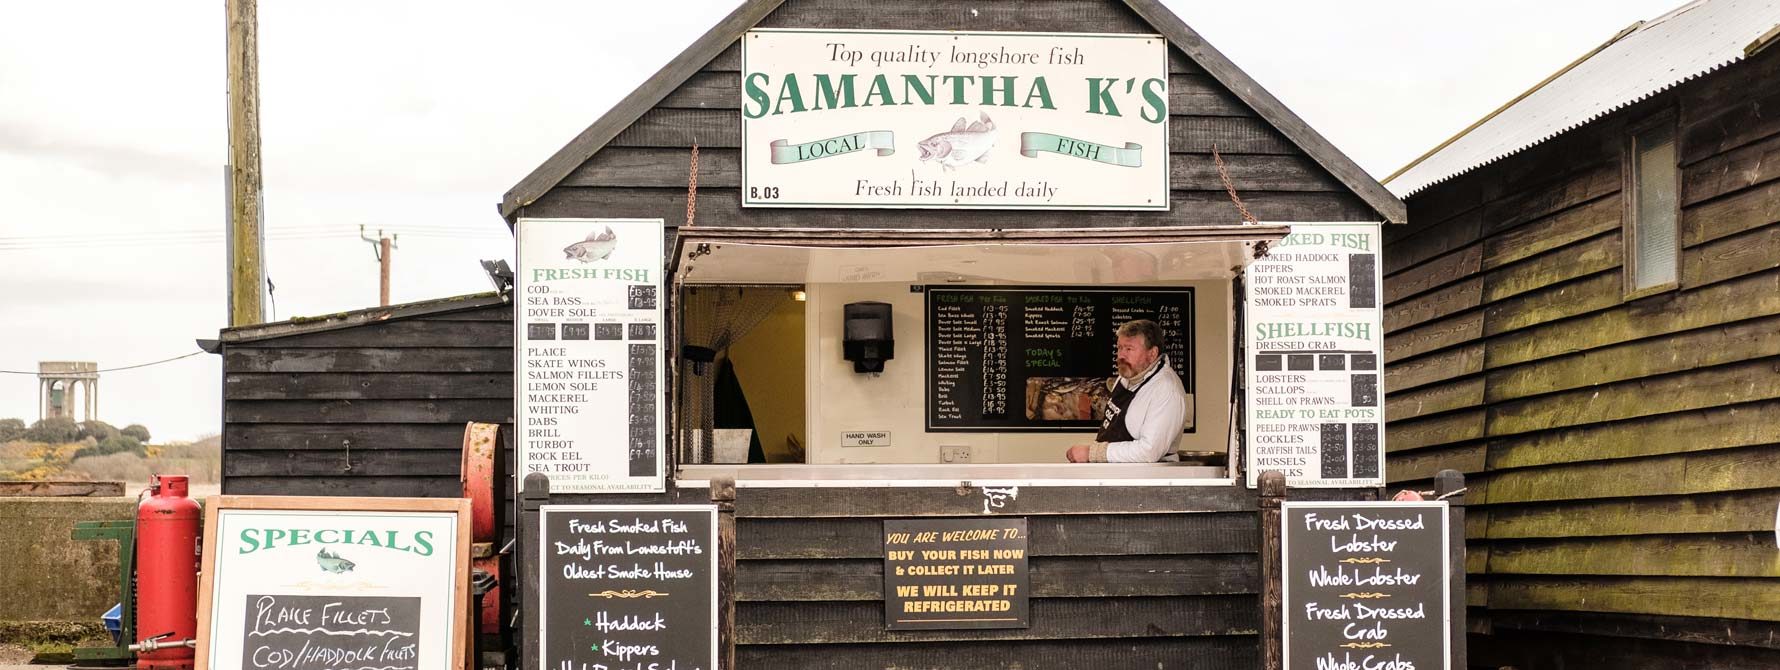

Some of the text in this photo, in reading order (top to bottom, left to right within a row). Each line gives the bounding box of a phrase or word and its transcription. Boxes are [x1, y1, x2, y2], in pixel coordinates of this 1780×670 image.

[826, 43, 1085, 69] Top quality longshore fish
[744, 72, 1167, 124] SAMANTHA K'S
[798, 135, 866, 160] LOCAL
[1057, 138, 1101, 160] FISH
[855, 173, 1058, 202] Fresh fish landed daily
[1331, 233, 1370, 251] FISH
[1295, 254, 1339, 262] HADDOCK
[533, 268, 649, 282] FRESH FISH
[1255, 276, 1346, 284] HOT ROAST SALMON
[527, 286, 549, 294] COD
[1255, 287, 1345, 295] SMOKED MACKEREL
[527, 297, 548, 305] SEA
[553, 297, 581, 305] BASS
[1255, 298, 1337, 306] SMOKED SPRATS
[528, 309, 565, 317] DOVER
[568, 309, 597, 317] SOLE
[1256, 322, 1370, 341] SHELLFISH
[1256, 341, 1336, 350] DRESSED CRAB
[528, 348, 566, 356] PLAICE
[528, 360, 606, 368] SKATE WINGS
[528, 371, 624, 379] SALMON FILLETS
[1256, 375, 1306, 383] LOBSTERS
[528, 383, 598, 391] LEMON SOLE
[1256, 386, 1305, 394] SCALLOPS
[528, 394, 589, 403] MACKEREL
[1256, 397, 1335, 405] SHELL ON PRAWNS
[528, 406, 579, 414] WHITING
[1256, 409, 1375, 419] READY TO EAT POTS
[528, 417, 558, 426] DABS
[528, 429, 560, 437] BRILL
[1256, 424, 1319, 432] PEELED PRAWNS
[1256, 435, 1304, 443] COCKLES
[528, 440, 574, 449] TURBOT
[528, 452, 583, 460] ROCK EEL
[528, 464, 590, 472] SEA TROUT
[568, 518, 688, 534] Fresh Smoked Fish
[1305, 513, 1425, 531] Fresh Dressed
[886, 528, 1026, 545] YOU ARE WELCOME TO...
[239, 528, 434, 557] SPECIALS
[1331, 533, 1397, 552] Lobster
[554, 538, 703, 560] Daily From Lowestoft's
[888, 550, 1024, 561] BUY YOUR FISH NOW
[563, 561, 693, 581] Oldest Smoke House
[895, 565, 1015, 575] & COLLECT IT LATER
[1309, 565, 1421, 587] Whole Lobster
[896, 584, 1017, 597] WE WILL KEEP IT
[903, 600, 1011, 612] REFRIGERATED
[1305, 602, 1425, 620] Fresh Dressed
[255, 595, 391, 632] PLAICE FILLETS
[595, 611, 666, 633] Haddock
[1343, 621, 1387, 640] Crab
[602, 639, 659, 661] Kippers
[1316, 652, 1415, 670] Whole Crabs
